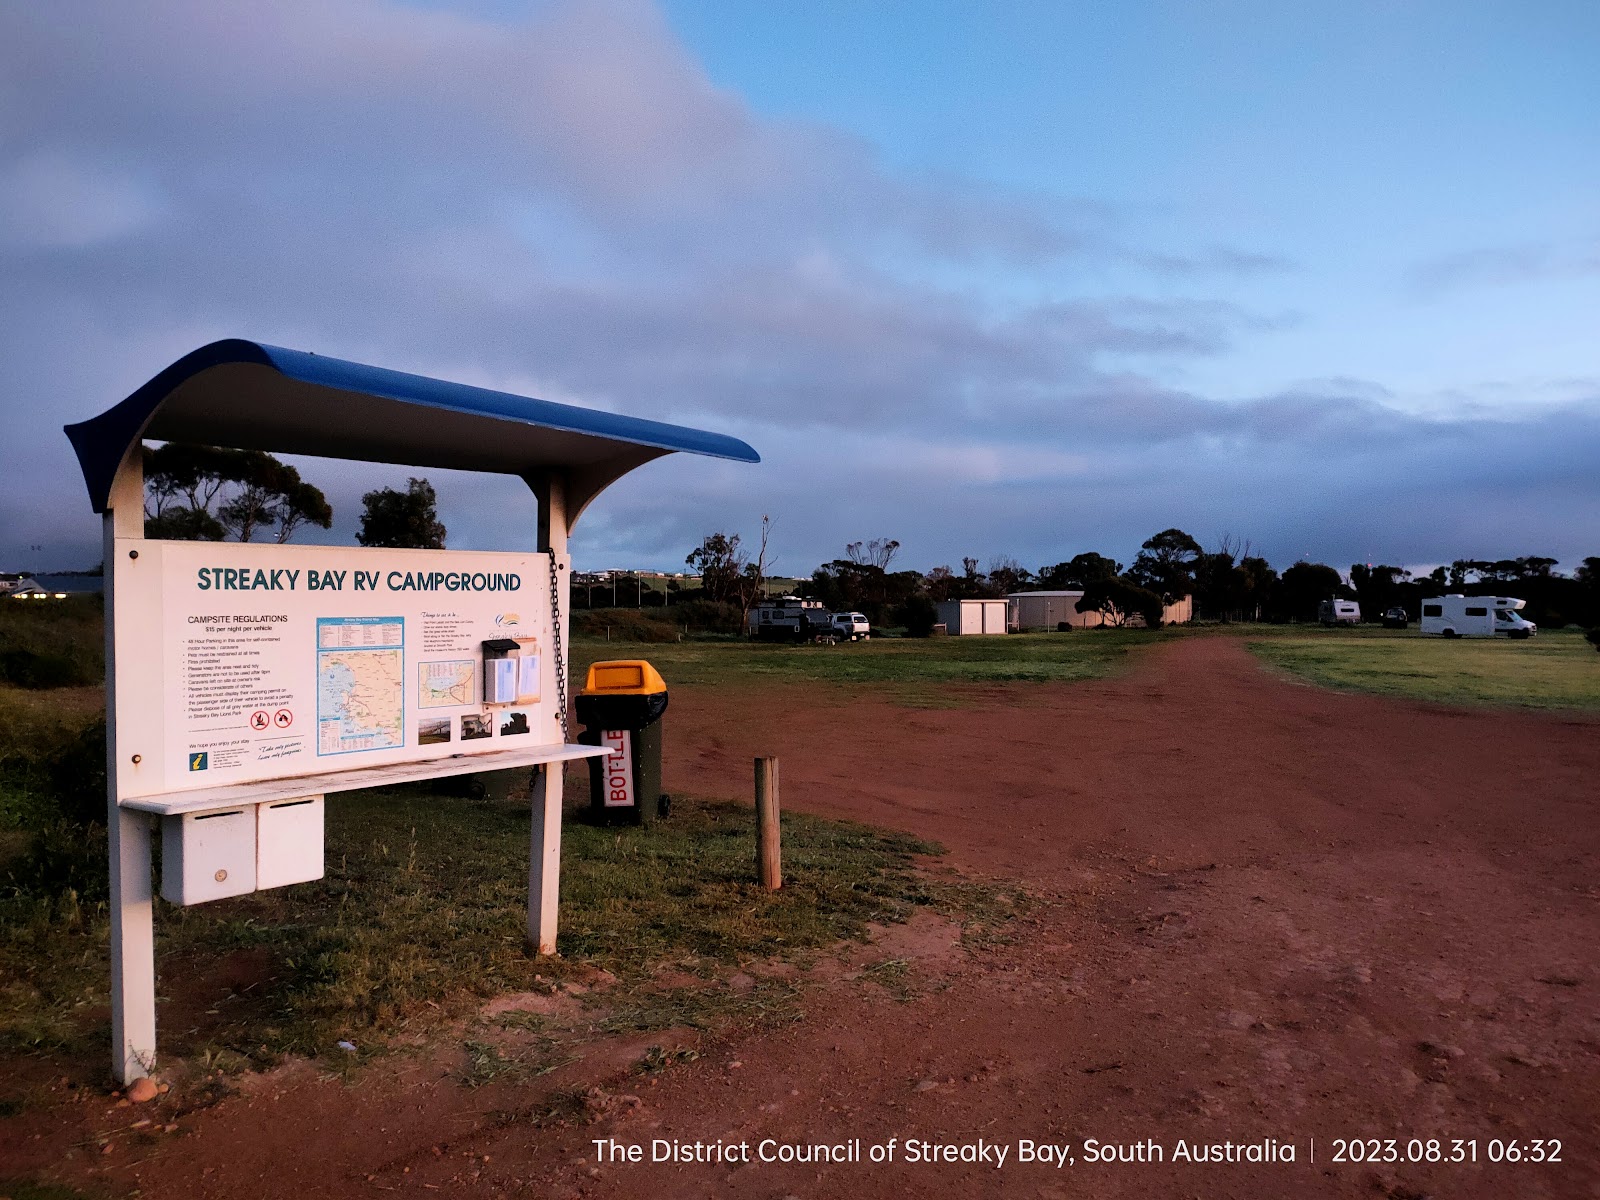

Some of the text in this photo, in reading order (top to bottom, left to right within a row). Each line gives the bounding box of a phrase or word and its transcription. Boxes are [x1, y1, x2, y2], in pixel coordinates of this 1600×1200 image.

[198, 568, 521, 591] STREAKY BAY RV CAMPGROUND
[188, 615, 230, 624] CAMPSITE
[607, 730, 627, 801] BOTTLE
